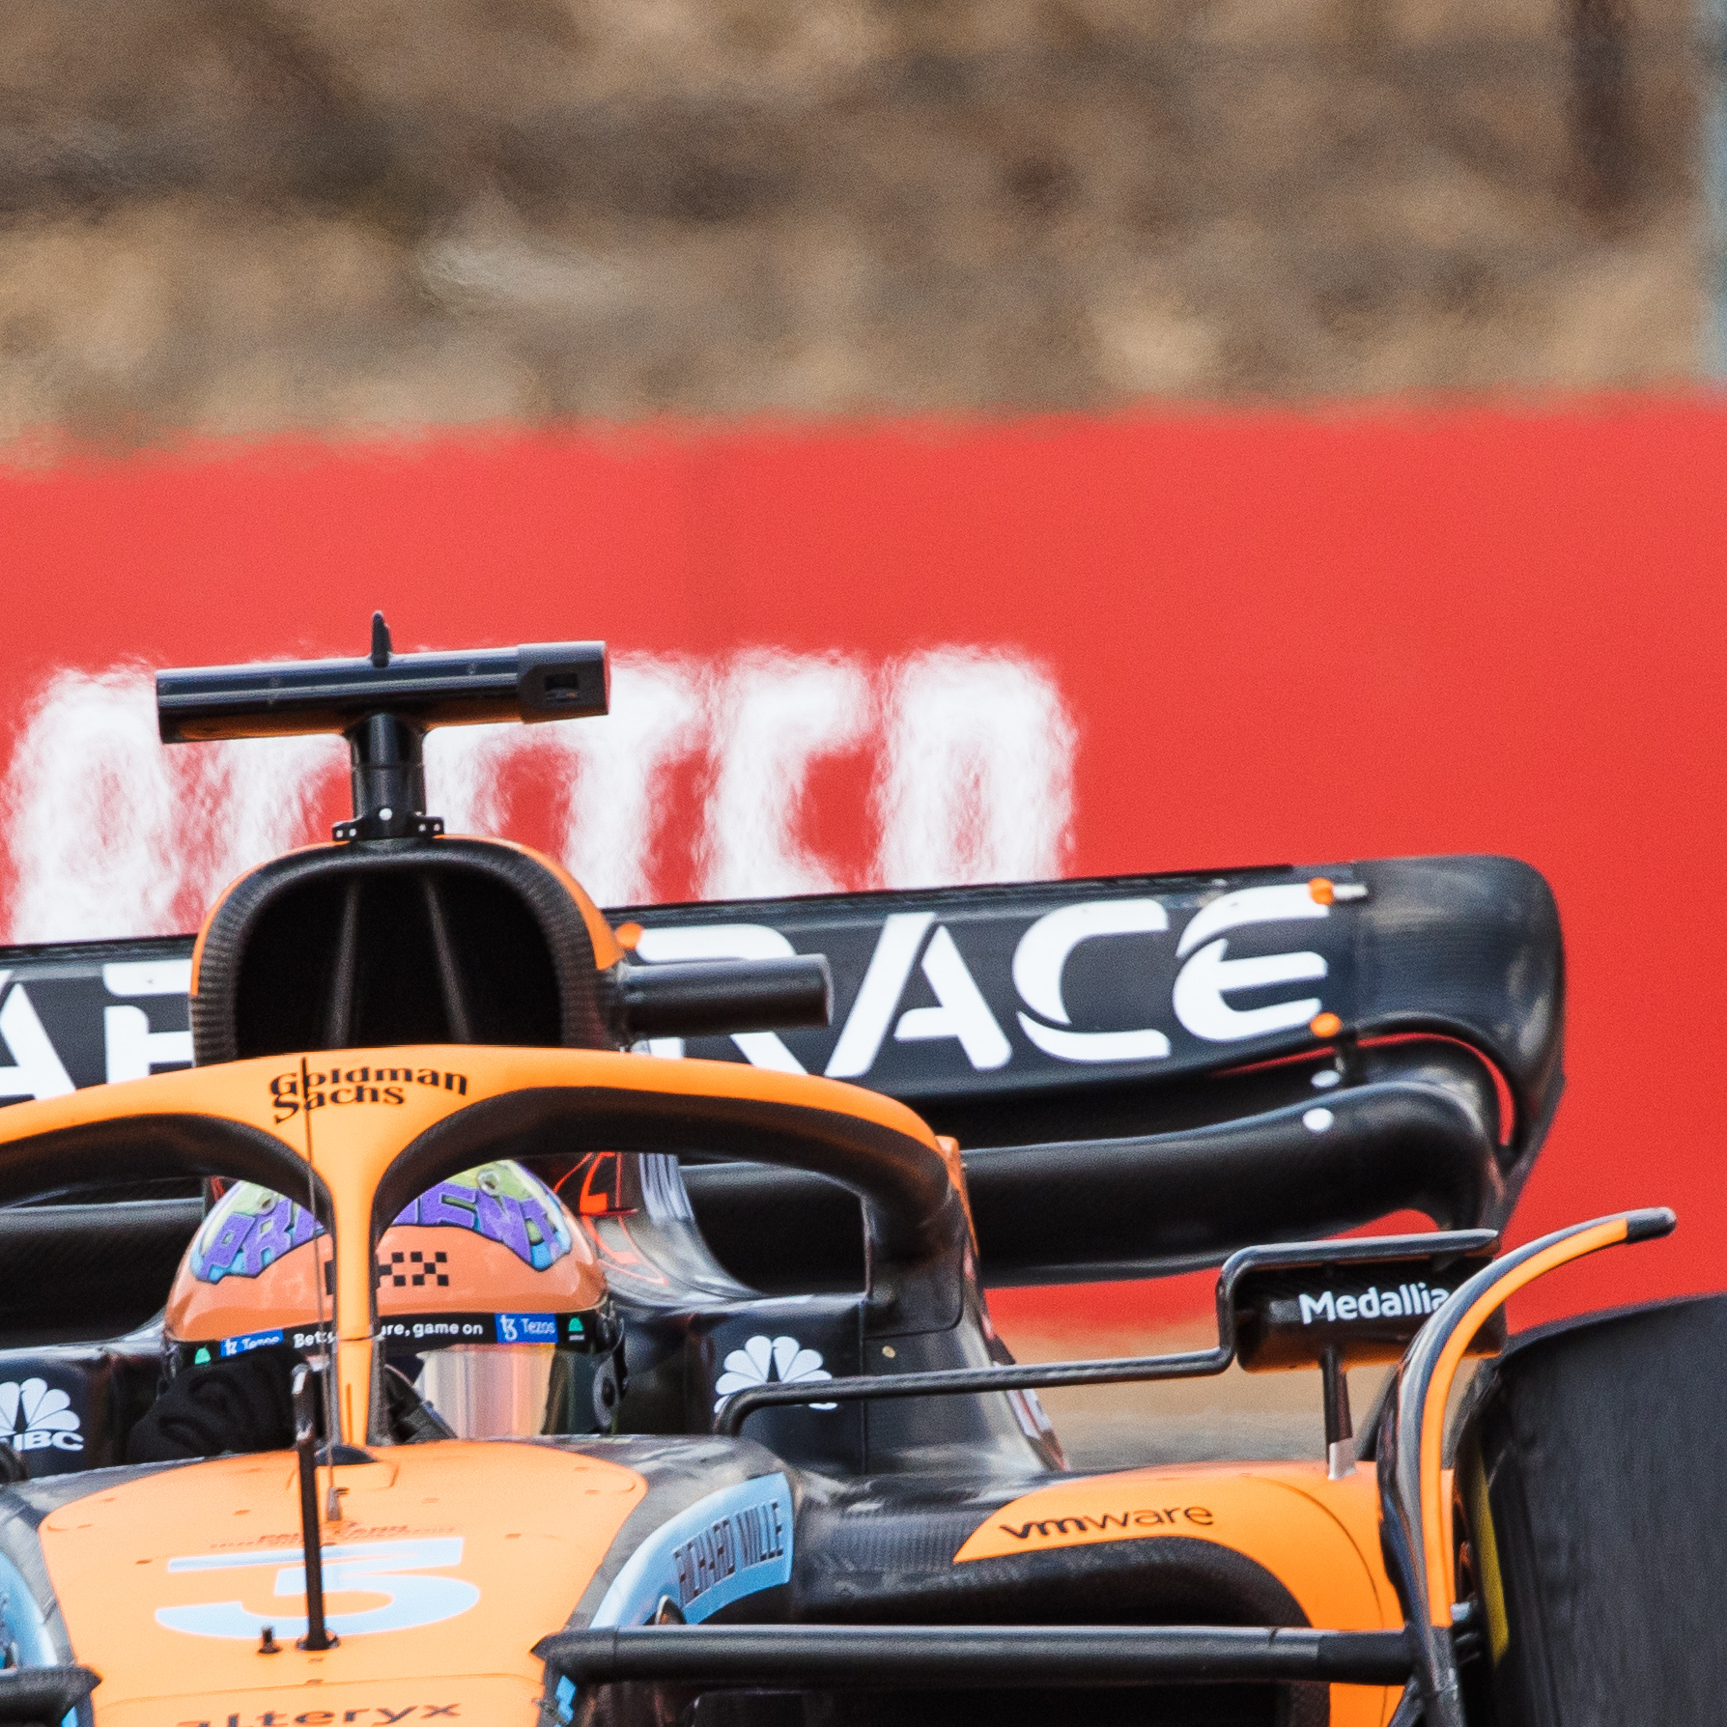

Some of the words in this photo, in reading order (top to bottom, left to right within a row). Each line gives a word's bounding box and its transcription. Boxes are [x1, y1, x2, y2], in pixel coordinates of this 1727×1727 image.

[269, 1065, 468, 1097] Goldman
[272, 1084, 406, 1125] Sachs
[1298, 1282, 1451, 1325] Medallia
[412, 1323, 459, 1340] game
[462, 1322, 483, 1336] on
[522, 1318, 556, 1336] Tezos
[998, 1505, 1215, 1540] vmware
